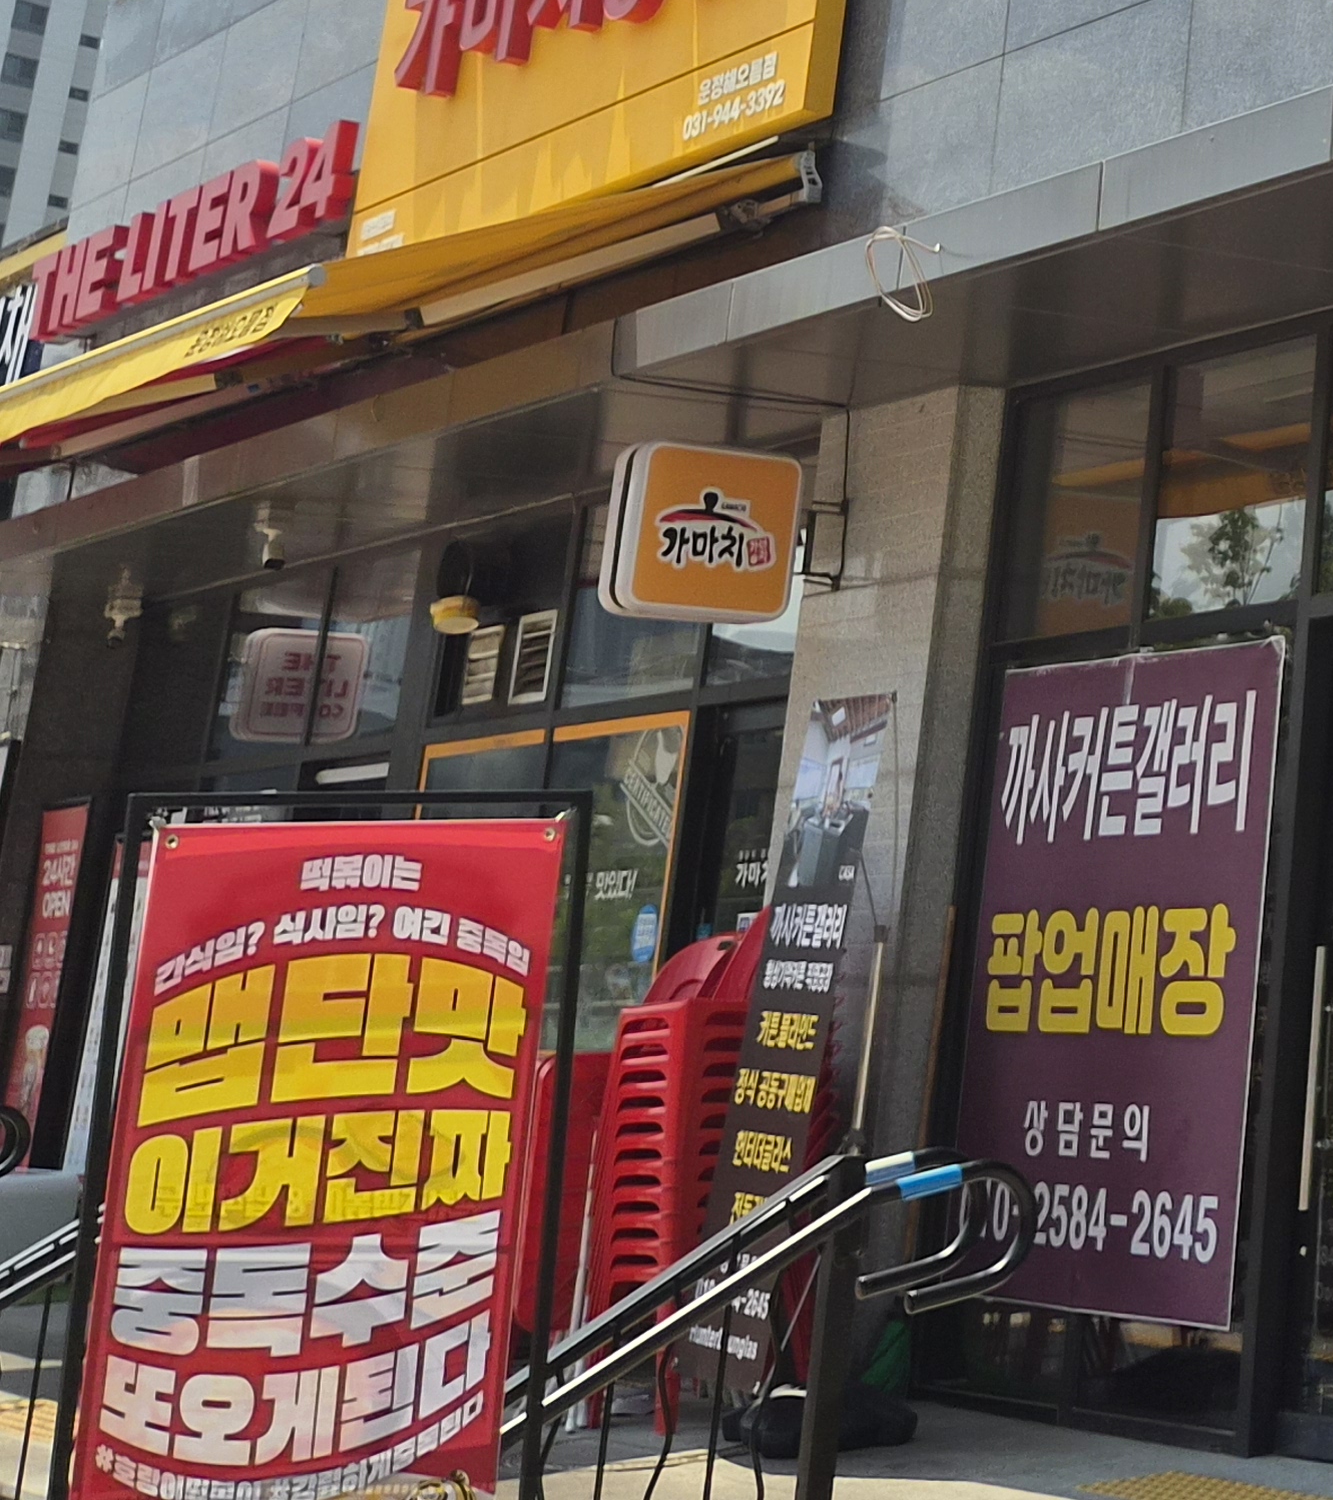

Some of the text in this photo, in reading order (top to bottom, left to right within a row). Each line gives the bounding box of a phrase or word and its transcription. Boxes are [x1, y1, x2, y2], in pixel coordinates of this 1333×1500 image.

[683, 79, 785, 140] 031-944-3392
[30, 120, 357, 341] THE LITER 24
[661, 525, 744, 568] 가마치
[1001, 690, 1257, 845] 까사커튼갤러리
[41, 890, 72, 918] OPEN
[300, 854, 423, 892] 떡볶이는
[154, 904, 531, 996] 간식임? 식사임? 여긴 중독임
[985, 903, 1237, 1036] 팝업매장
[137, 952, 526, 1128] 맵단맛
[124, 1110, 512, 1236] 이거진짜
[111, 1210, 501, 1359] 중독수준
[101, 1309, 492, 1468] 또오게된다
